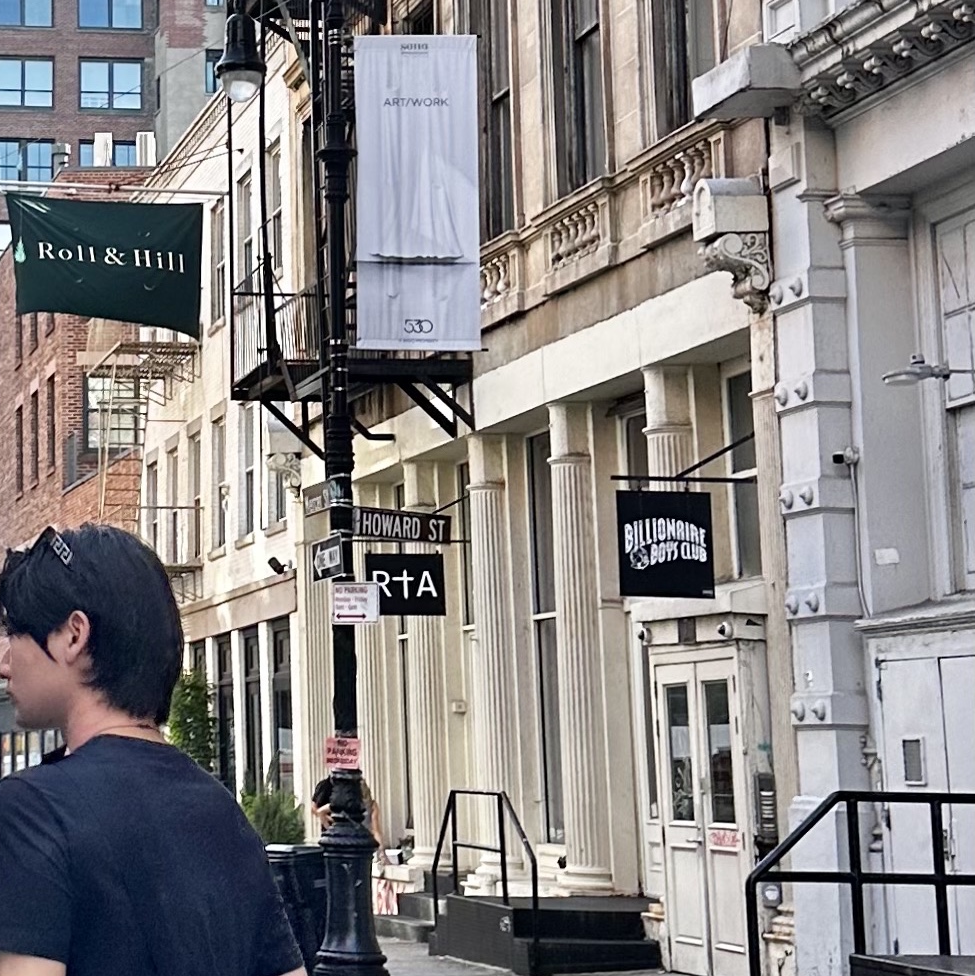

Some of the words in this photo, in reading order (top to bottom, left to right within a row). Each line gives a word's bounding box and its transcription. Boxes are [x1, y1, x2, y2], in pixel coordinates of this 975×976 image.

[383, 97, 449, 108] ART/WORK
[37, 241, 97, 264] Roll
[104, 247, 127, 266] &
[134, 249, 185, 274] Hill
[403, 319, 434, 334] 530
[362, 512, 421, 540] HOWARD
[428, 518, 446, 542] ST
[624, 517, 707, 554] BILLIONAIRE
[650, 540, 679, 566] BOYS
[681, 541, 708, 563] CLUB
